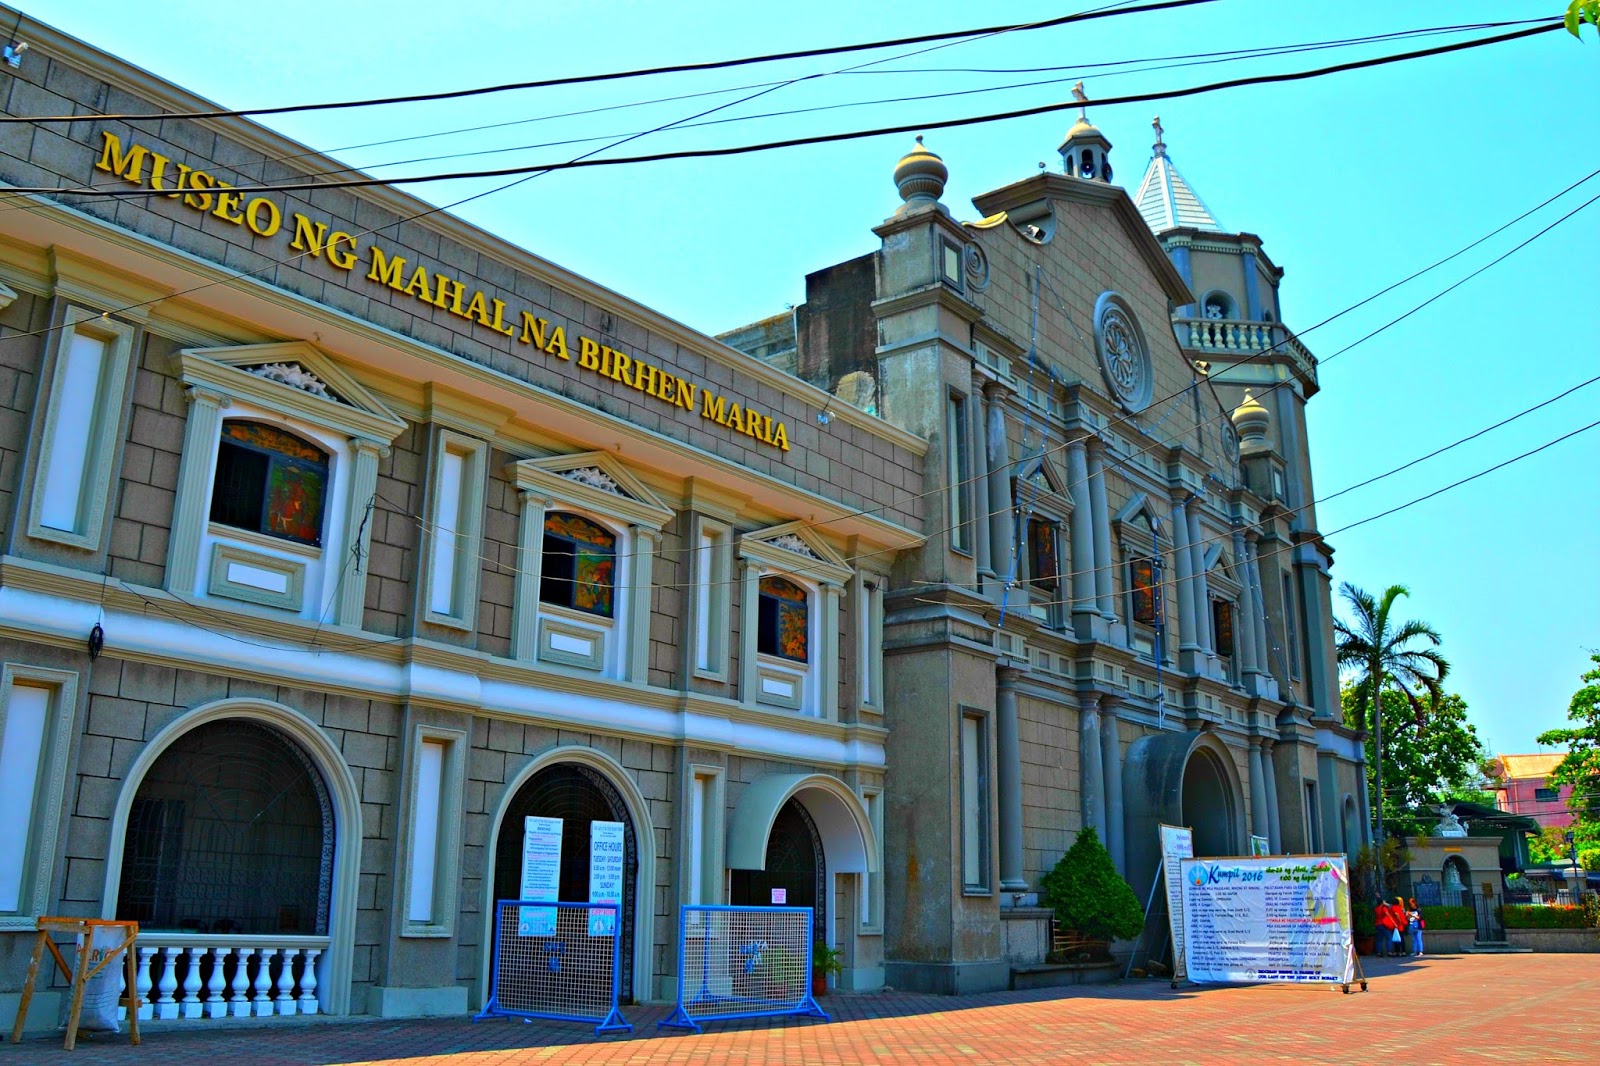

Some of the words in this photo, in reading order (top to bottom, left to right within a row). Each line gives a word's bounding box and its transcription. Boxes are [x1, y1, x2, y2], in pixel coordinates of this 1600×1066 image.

[96, 131, 282, 238] MUSEO
[290, 212, 358, 271] NG
[368, 245, 515, 338] MAHAL
[520, 311, 571, 362] NA
[579, 336, 697, 412] BIRHEN
[702, 389, 791, 452] MARIA
[593, 841, 607, 851] OFFICE
[608, 842, 622, 852] HOURS
[1208, 865, 1240, 885] Kumpil
[1242, 871, 1263, 881] 2016
